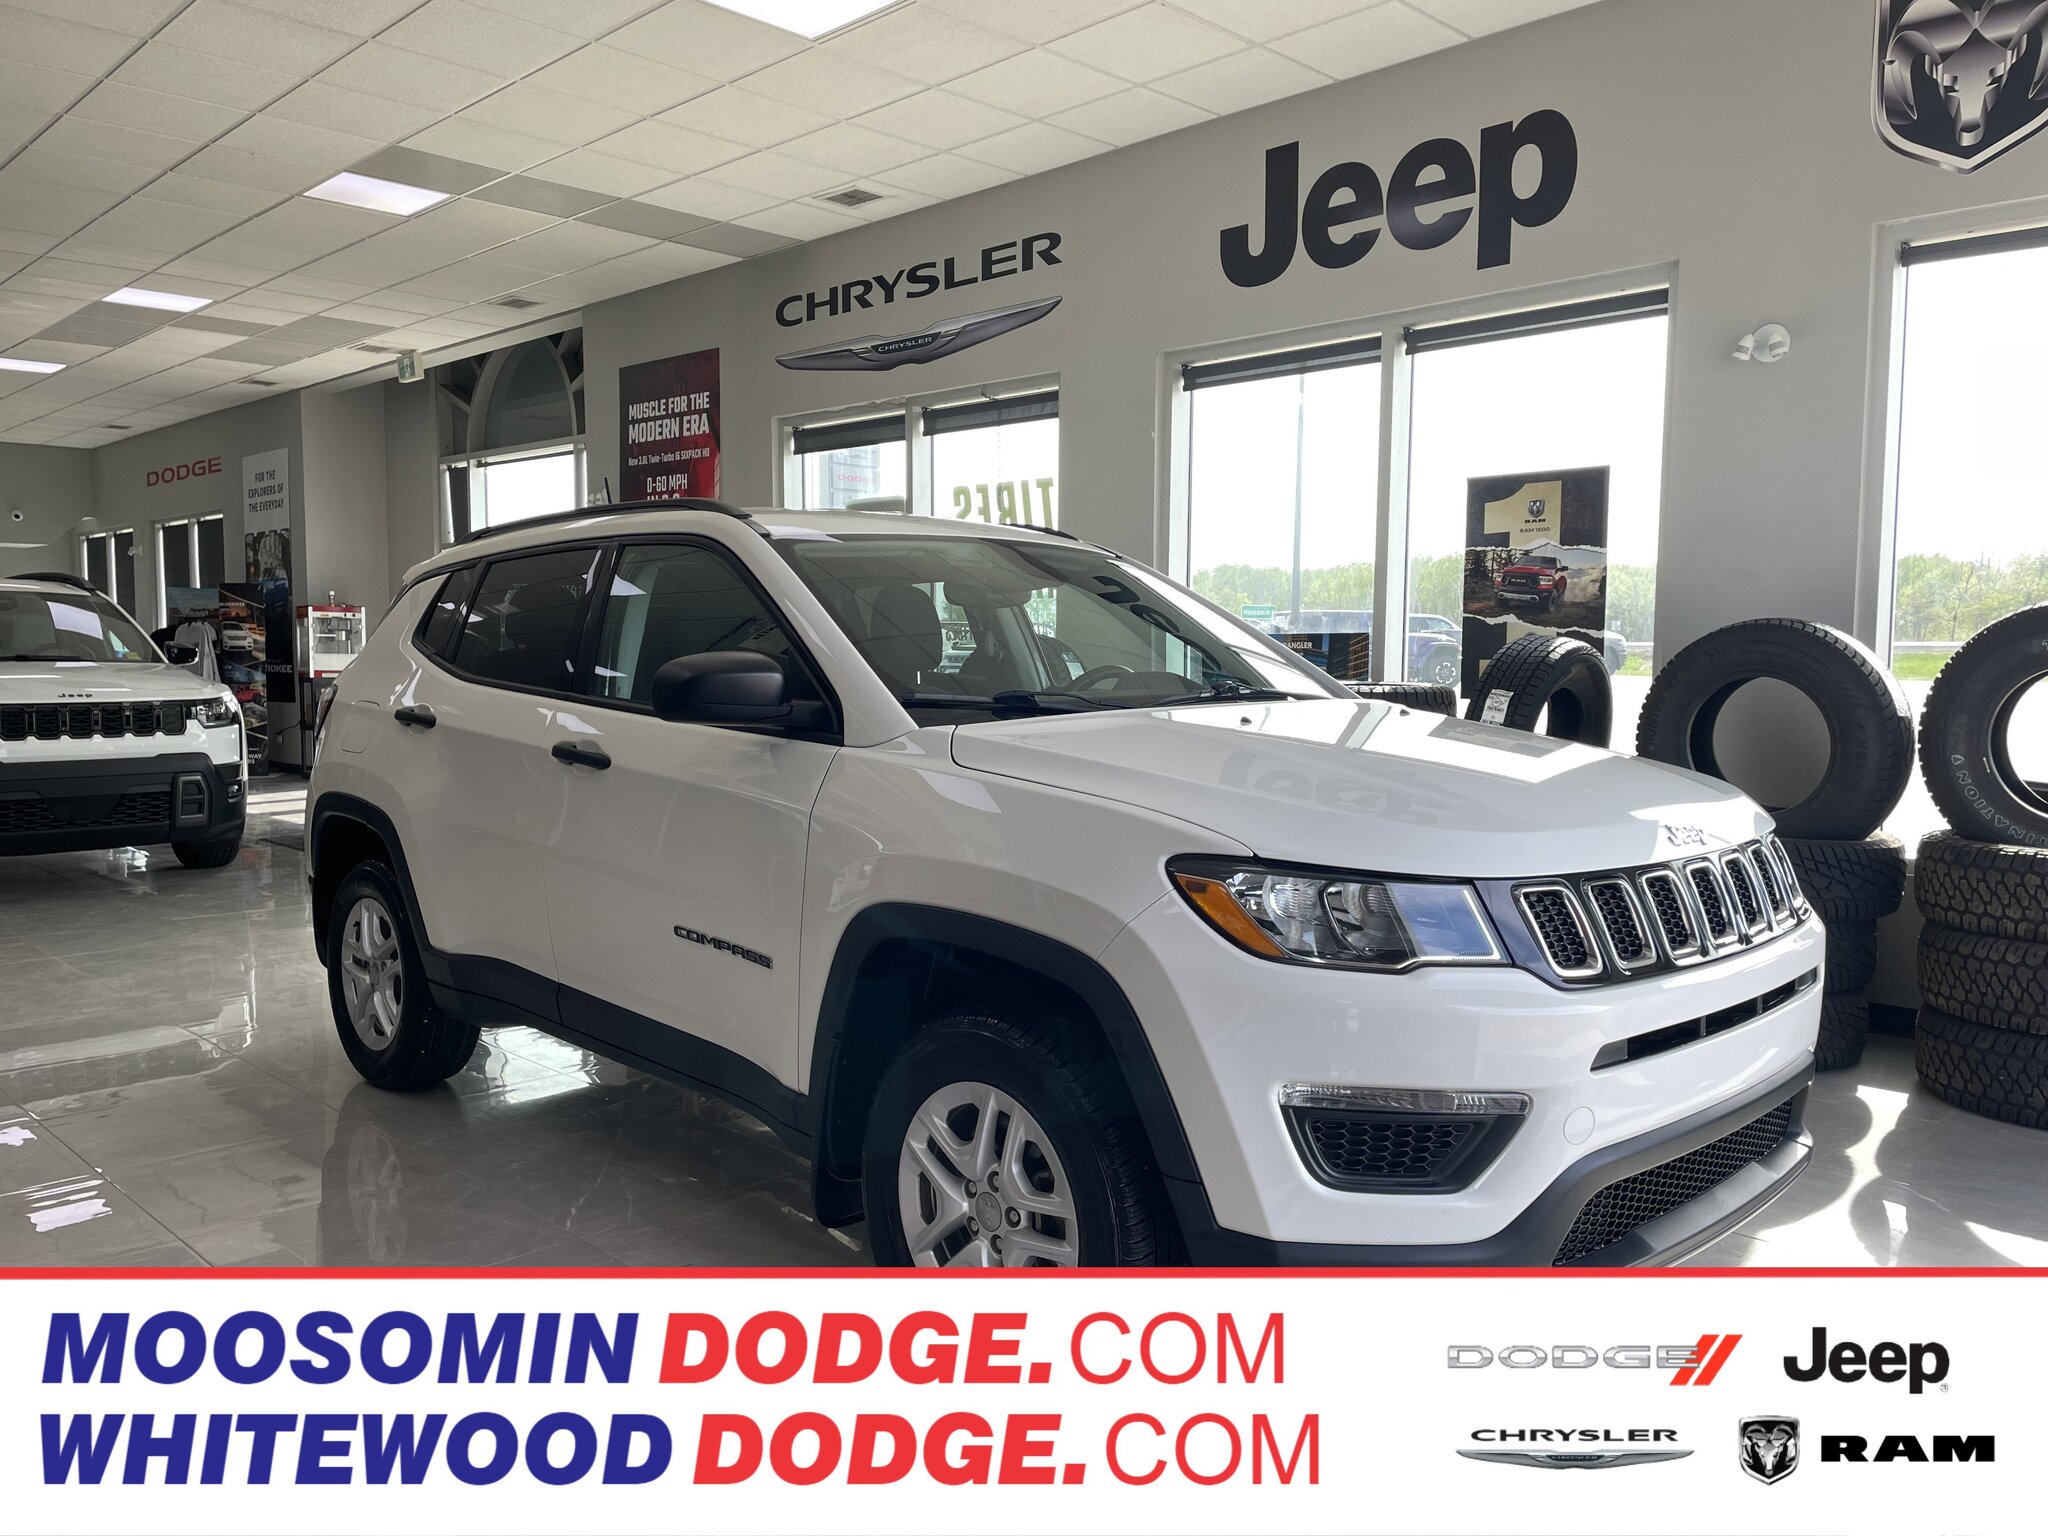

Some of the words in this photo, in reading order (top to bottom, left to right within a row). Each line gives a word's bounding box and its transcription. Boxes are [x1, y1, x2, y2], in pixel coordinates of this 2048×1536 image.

[1220, 109, 1578, 288] Jeep
[775, 232, 1062, 327] CHRYSLER
[878, 336, 932, 352] CHRYSLER
[628, 398, 666, 421] MUSCLE
[668, 395, 687, 415] FOR
[690, 391, 710, 411] THE
[628, 417, 680, 445] MODERN
[682, 412, 710, 437] ERA
[146, 456, 222, 488] DODGE
[628, 457, 638, 466] New
[255, 471, 265, 483] FOR
[265, 469, 276, 480] THE
[647, 475, 667, 493] 0-60
[668, 473, 688, 491] MPH
[248, 484, 276, 499] EXPLORERS
[276, 482, 284, 494] OF
[249, 502, 258, 513] THE
[259, 498, 284, 512] EVERYDAY
[673, 925, 774, 970] COMPASS
